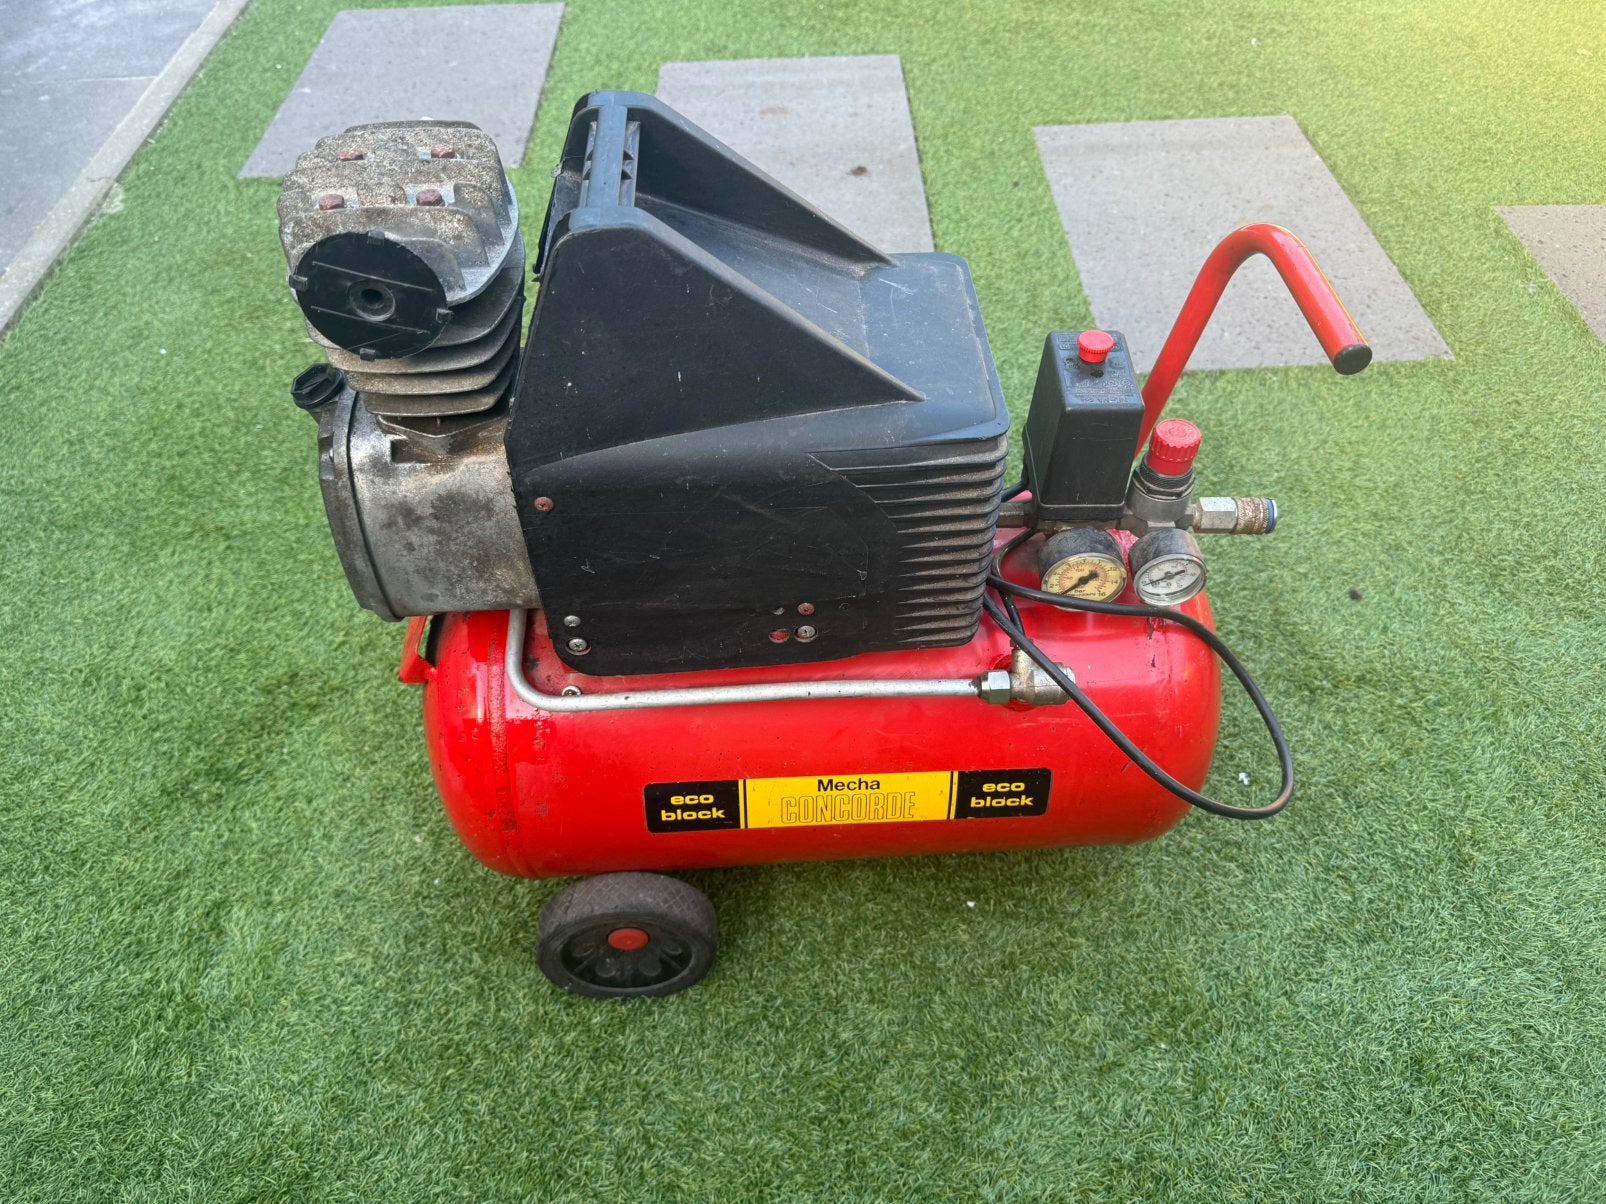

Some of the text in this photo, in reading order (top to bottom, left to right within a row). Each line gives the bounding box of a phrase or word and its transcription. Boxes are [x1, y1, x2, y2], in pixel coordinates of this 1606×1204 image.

[817, 777, 881, 792] Mecha
[982, 782, 1026, 793] eco
[670, 794, 714, 805] eco
[970, 795, 1034, 808] block
[661, 807, 726, 821] block
[780, 792, 916, 824] CONCORDE
